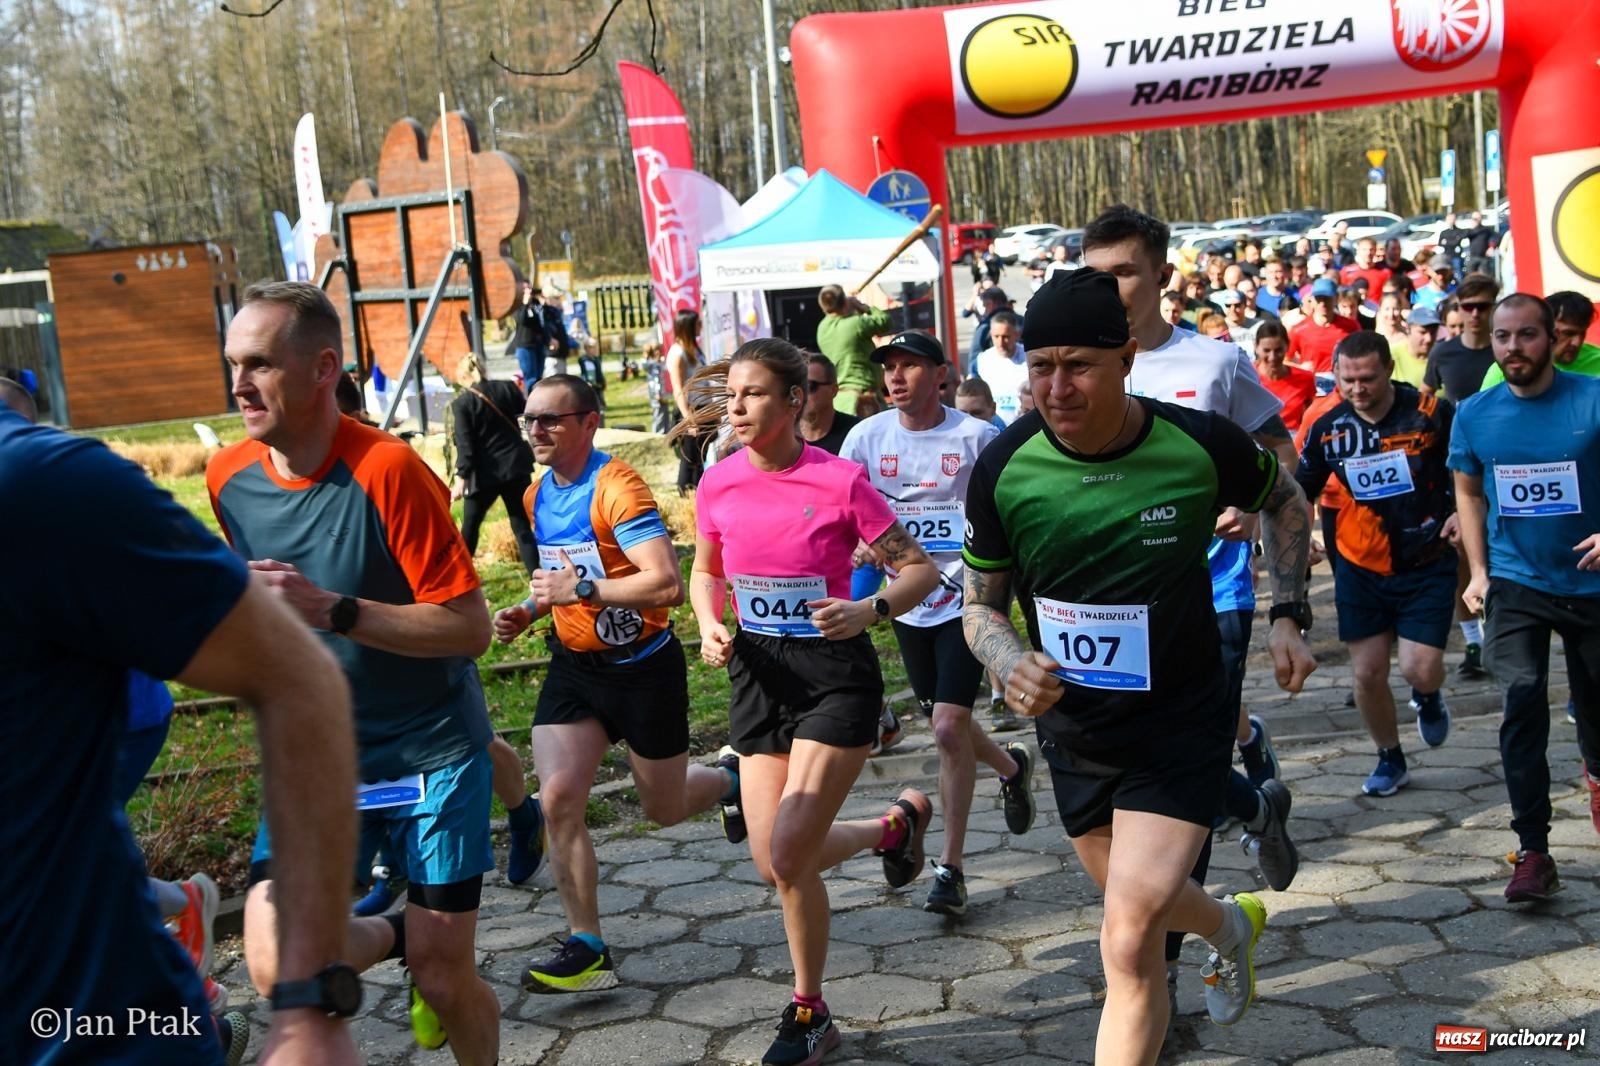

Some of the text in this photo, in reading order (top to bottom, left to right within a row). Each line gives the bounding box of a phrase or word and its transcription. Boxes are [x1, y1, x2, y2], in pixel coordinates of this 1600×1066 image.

[1103, 17, 1354, 67] TWARDZIELA
[1130, 62, 1330, 106] RACIBÓRZ
[1082, 473, 1116, 483] CRAFT
[1357, 467, 1400, 488] 042
[1511, 481, 1563, 502] 095
[1140, 506, 1177, 522] KMD
[905, 520, 952, 538] 025
[1163, 536, 1178, 544] KMD
[750, 597, 812, 620] 044
[1042, 604, 1138, 620] XIV BIEG TWARDZIELA
[1058, 631, 1121, 666] 107
